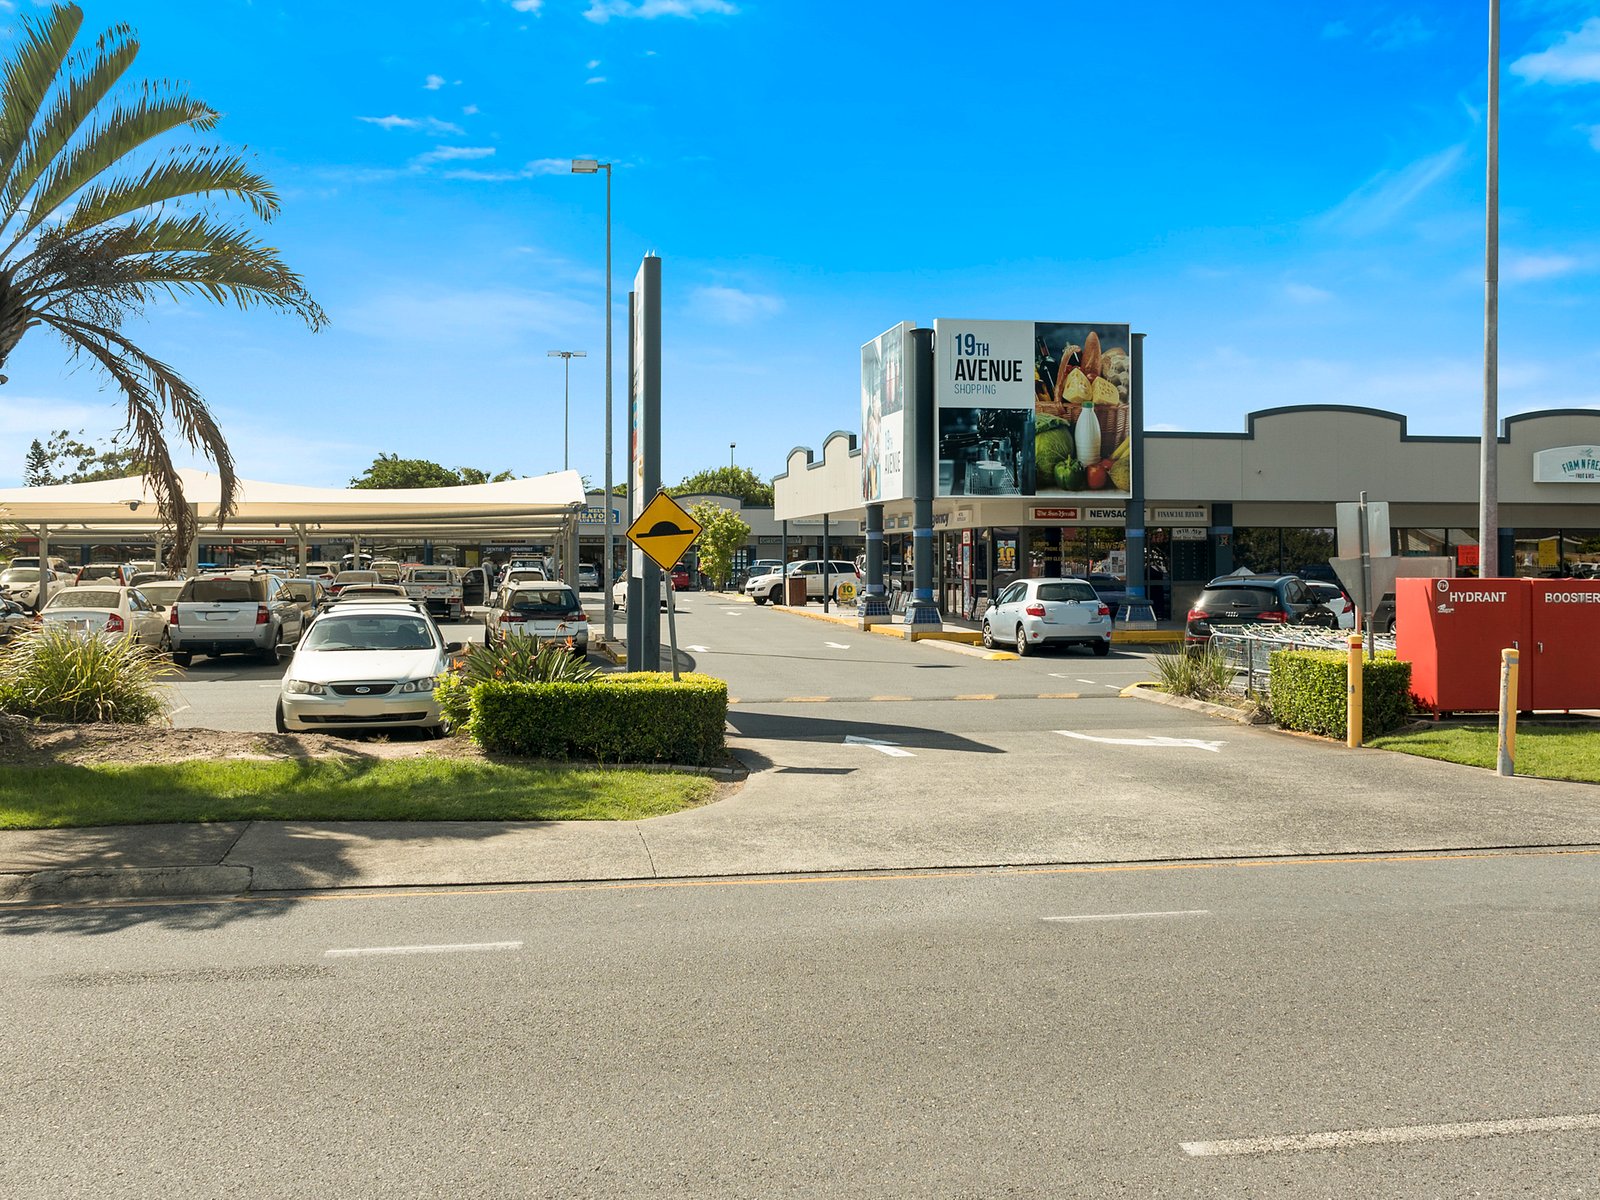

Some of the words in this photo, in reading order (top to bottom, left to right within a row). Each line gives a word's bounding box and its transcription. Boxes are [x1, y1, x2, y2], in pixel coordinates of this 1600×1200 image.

[955, 333, 989, 356] 19TH
[955, 359, 1023, 382] AVENUE
[954, 384, 996, 395] SHOPPING
[1561, 459, 1580, 473] FIRM
[1581, 458, 1586, 469] N
[842, 585, 853, 593] 10
[1450, 592, 1506, 602] HYDRANT
[1545, 592, 1600, 603] BOOSTER
